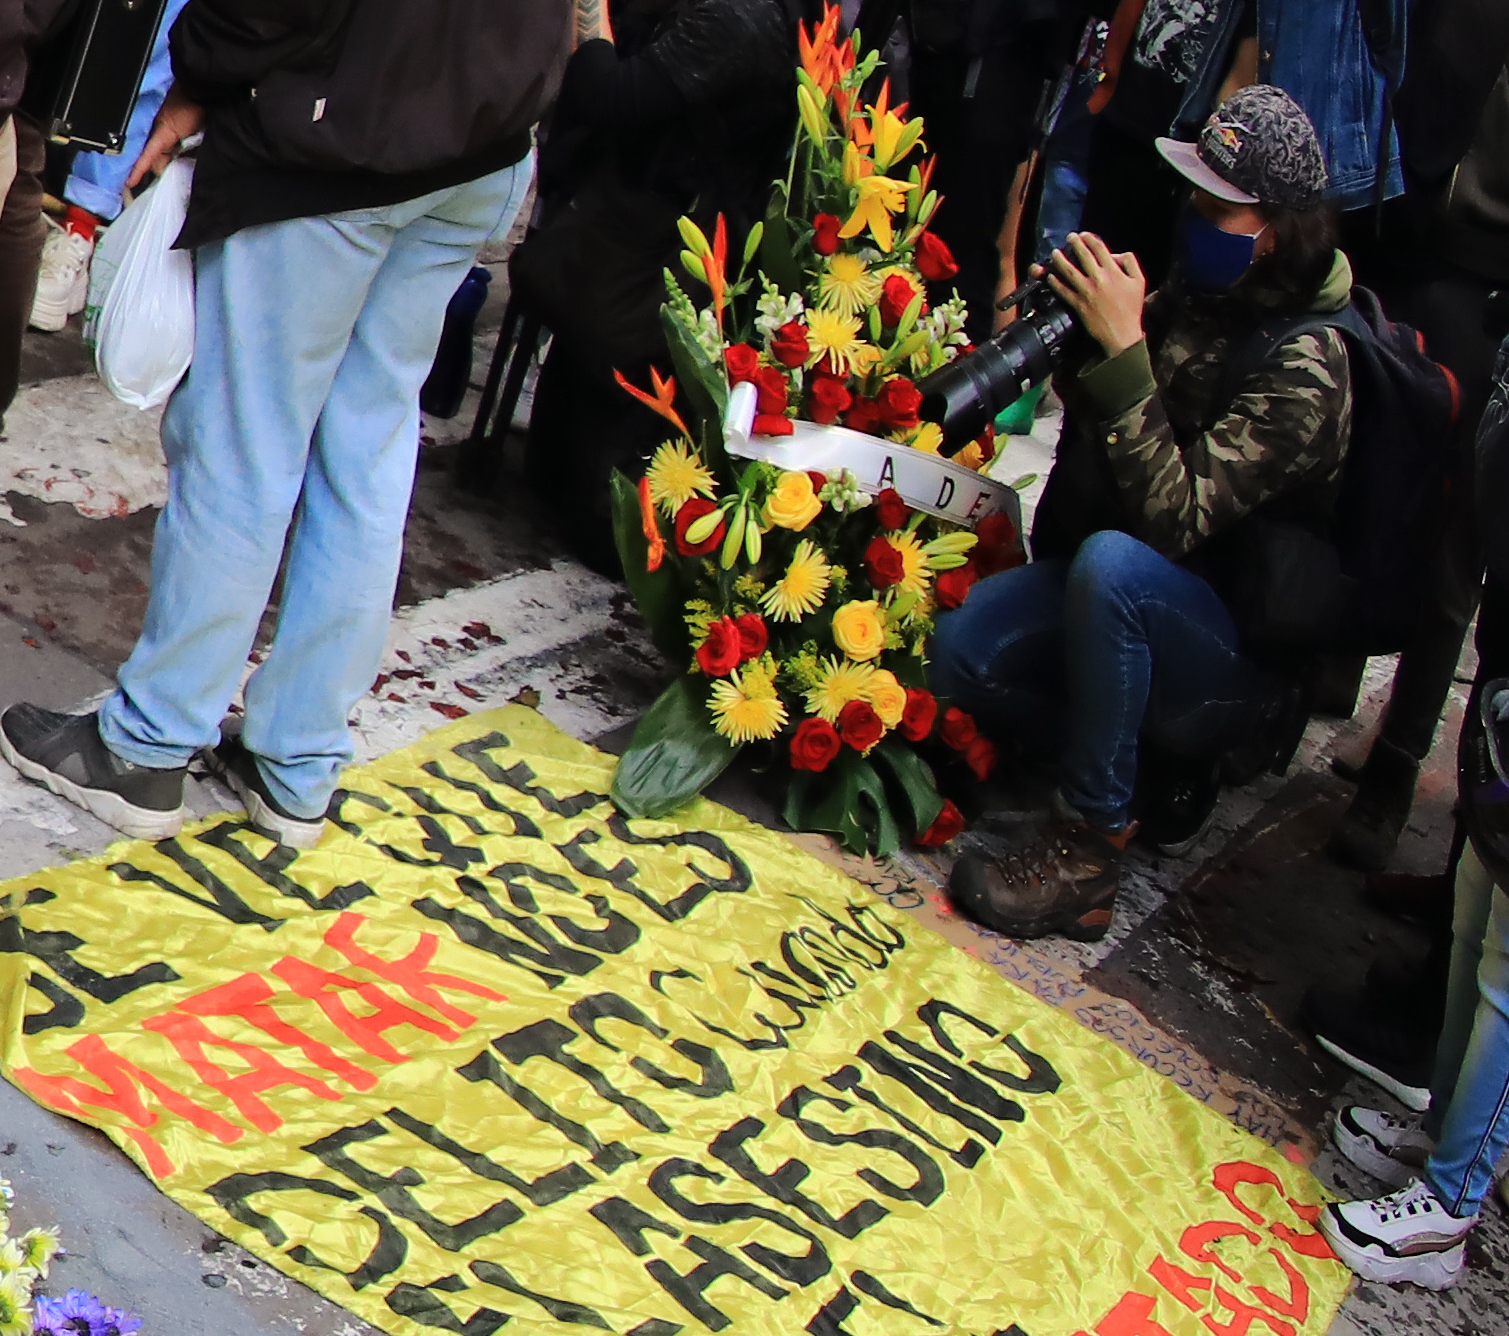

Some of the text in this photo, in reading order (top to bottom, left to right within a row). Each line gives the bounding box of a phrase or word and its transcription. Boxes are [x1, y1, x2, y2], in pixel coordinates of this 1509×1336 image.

[878, 455, 894, 489] A
[324, 730, 614, 871] QUE
[10, 910, 513, 1179] MATAR
[412, 863, 642, 991] NO
[556, 815, 754, 936] ES
[205, 889, 908, 1292] DELITO Cuando
[589, 997, 1063, 1333] ASESINO
